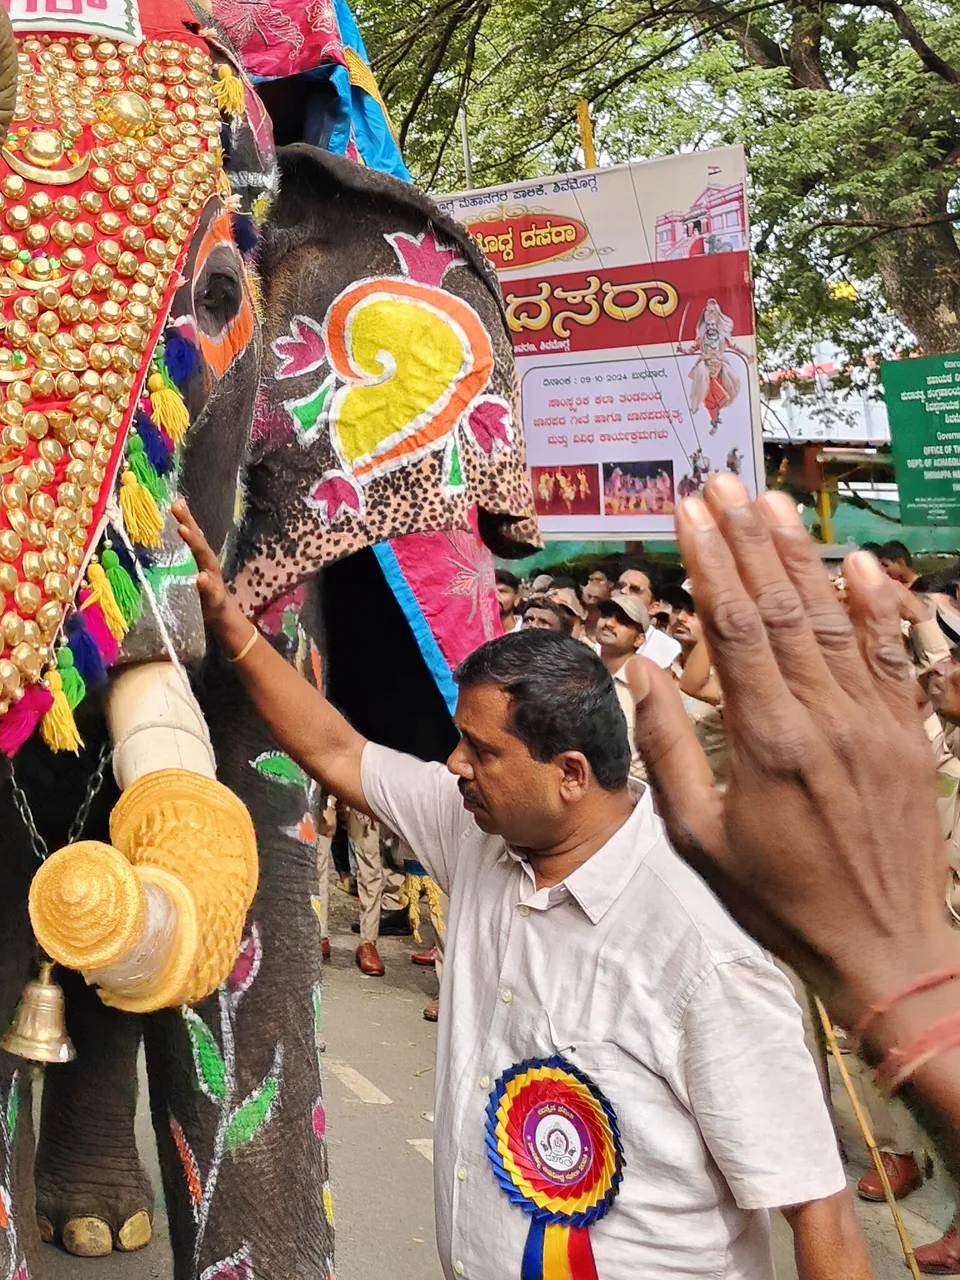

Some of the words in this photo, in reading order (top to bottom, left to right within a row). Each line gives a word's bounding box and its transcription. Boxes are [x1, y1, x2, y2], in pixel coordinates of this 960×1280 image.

[459, 191, 508, 208] ಮಹಾನಗರ
[552, 175, 598, 193] ಶಿವಮೊಗ್ಗ
[520, 221, 577, 248] ದಸರಾ
[505, 275, 679, 338] ದಸರಾ
